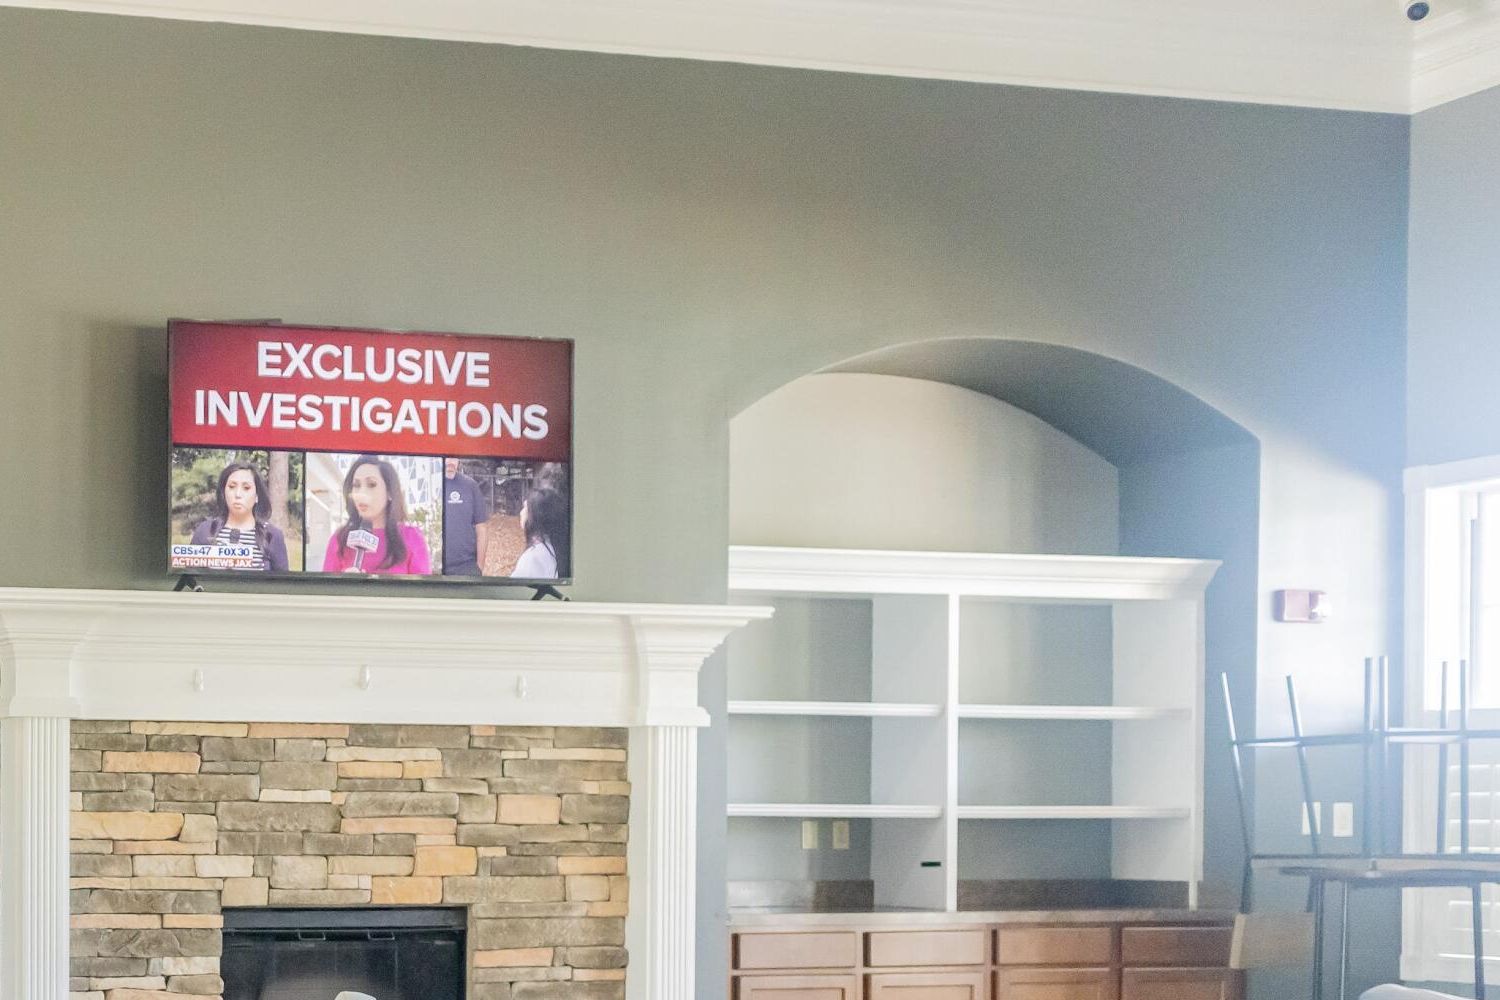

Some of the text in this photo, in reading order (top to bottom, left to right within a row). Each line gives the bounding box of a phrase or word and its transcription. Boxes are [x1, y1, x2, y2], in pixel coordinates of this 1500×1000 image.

[257, 340, 491, 388] EXCLUSIVE
[194, 389, 549, 441] INVESTIGATIONS
[172, 557, 253, 568] ACTION NEWS JAX
